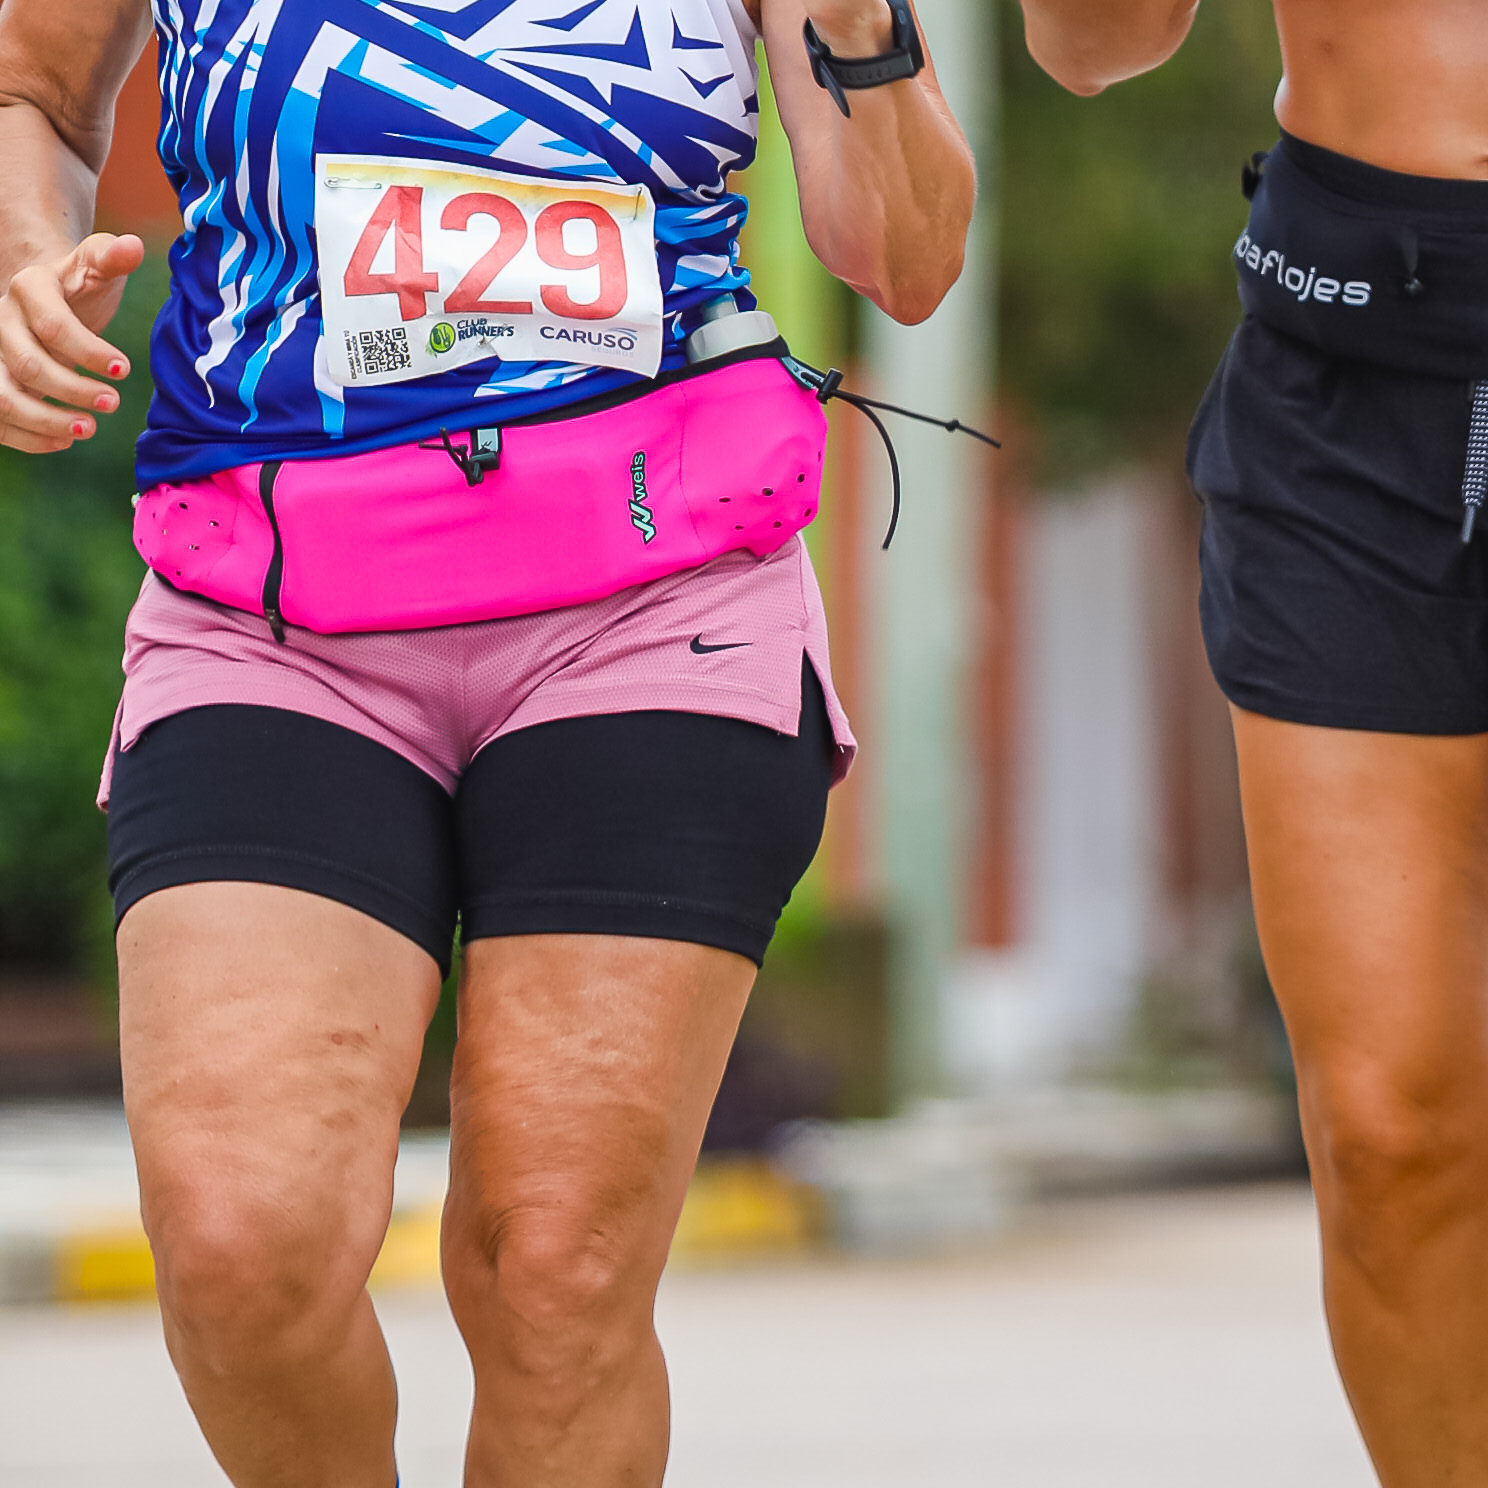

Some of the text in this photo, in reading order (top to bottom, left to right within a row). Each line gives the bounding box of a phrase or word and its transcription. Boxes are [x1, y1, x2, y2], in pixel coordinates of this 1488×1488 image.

[343, 185, 628, 322] 429
[1233, 229, 1371, 305] oaflojes
[457, 318, 487, 330] CLUB
[457, 326, 515, 342] RUNNER'S
[540, 326, 635, 351] CARUSO
[630, 452, 648, 502] weis
